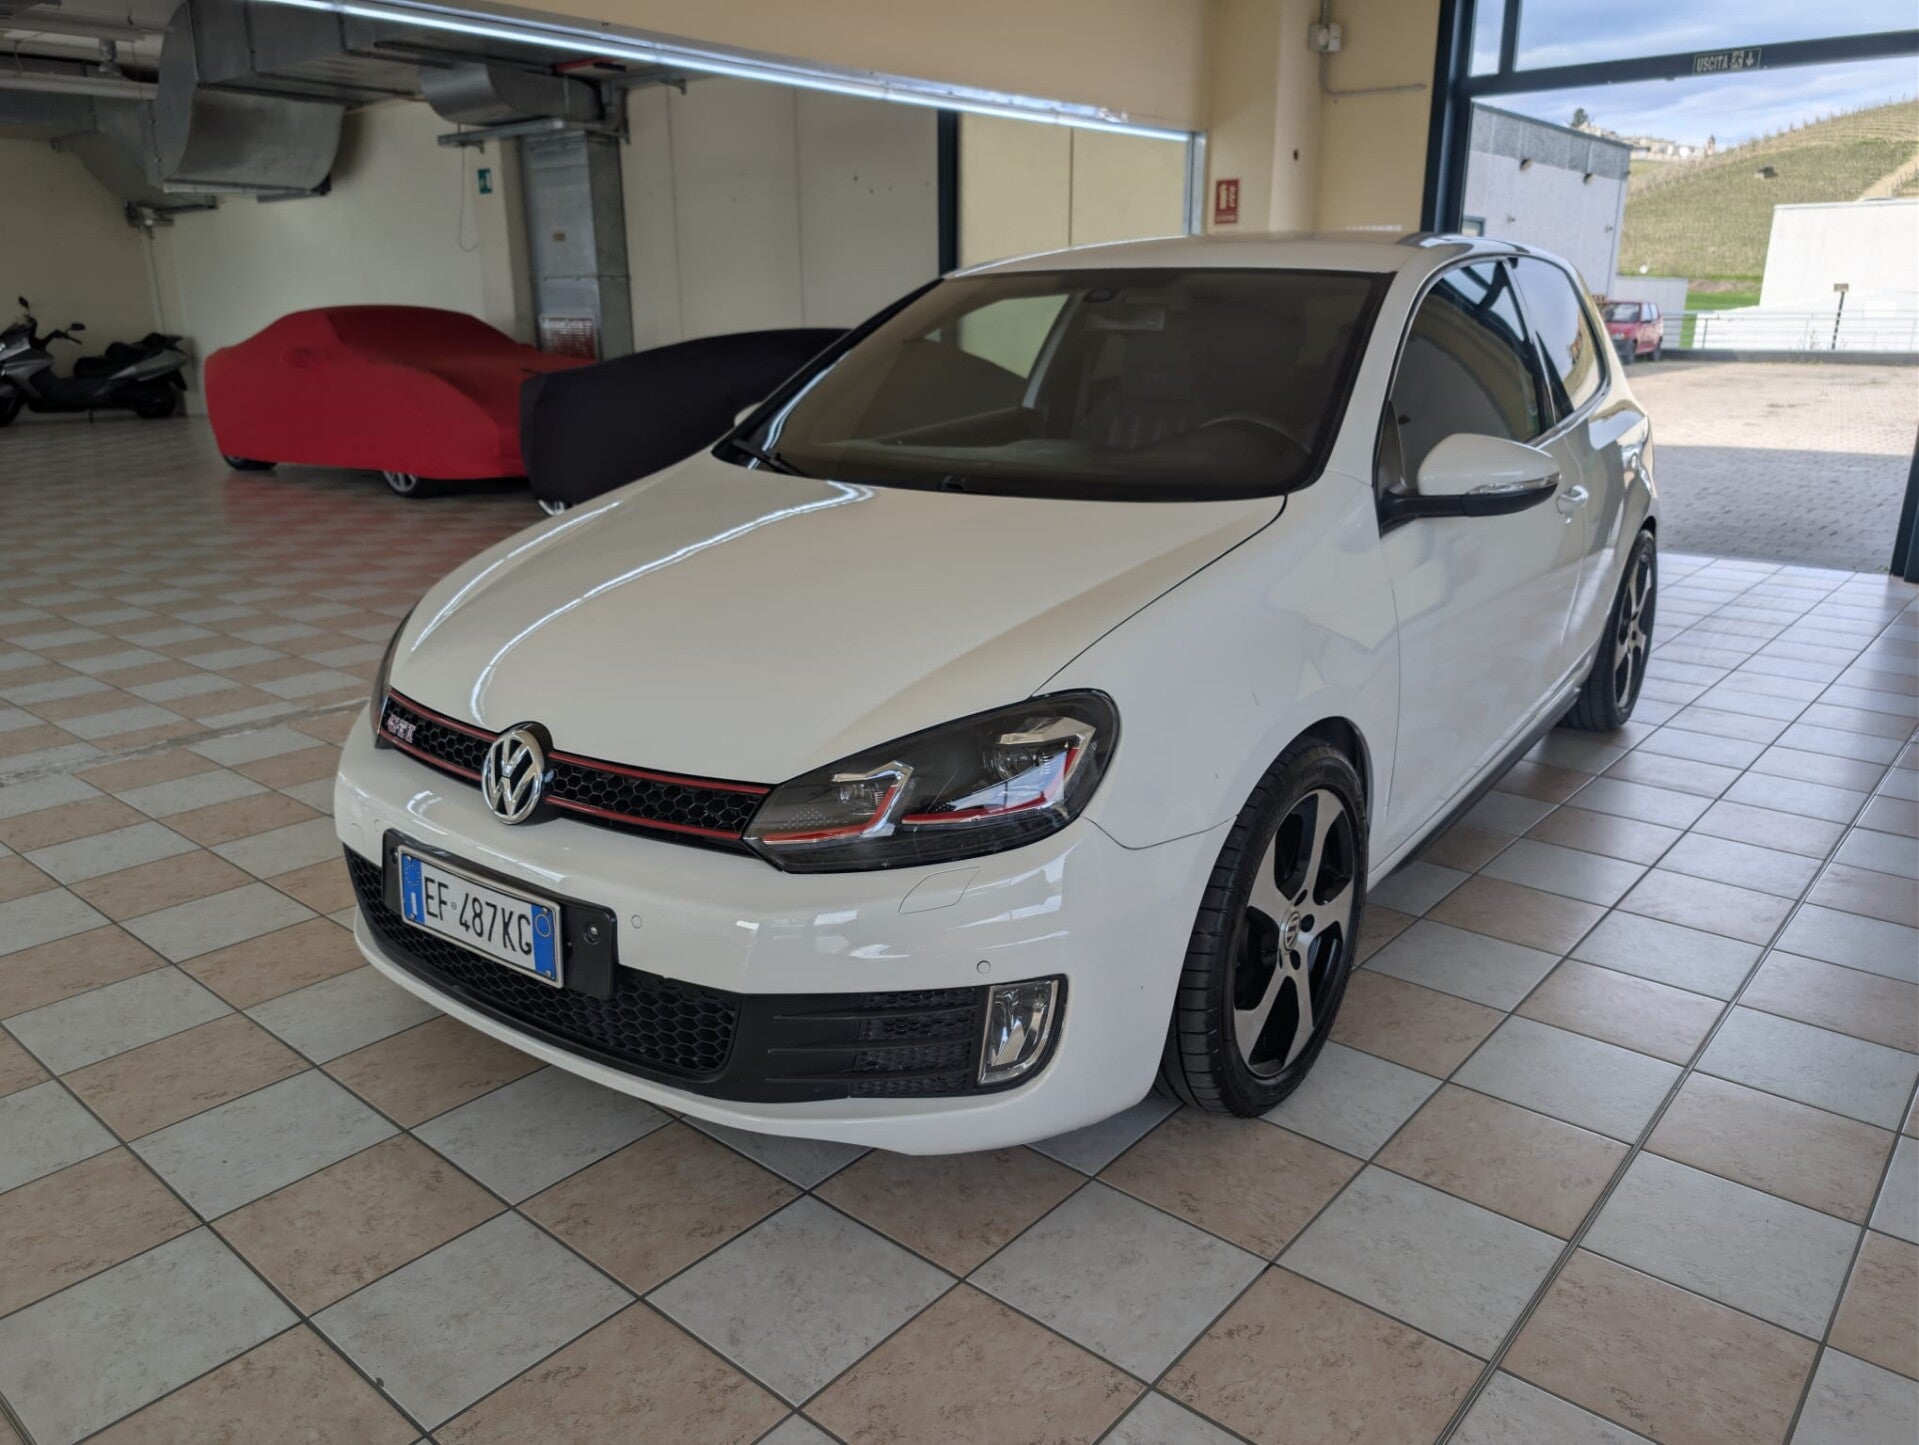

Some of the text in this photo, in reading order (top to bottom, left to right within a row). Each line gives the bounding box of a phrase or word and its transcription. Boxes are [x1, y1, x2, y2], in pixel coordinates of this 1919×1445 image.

[1696, 55, 1728, 72] USCITA
[387, 713, 417, 743] GTI
[482, 729, 544, 825] VW
